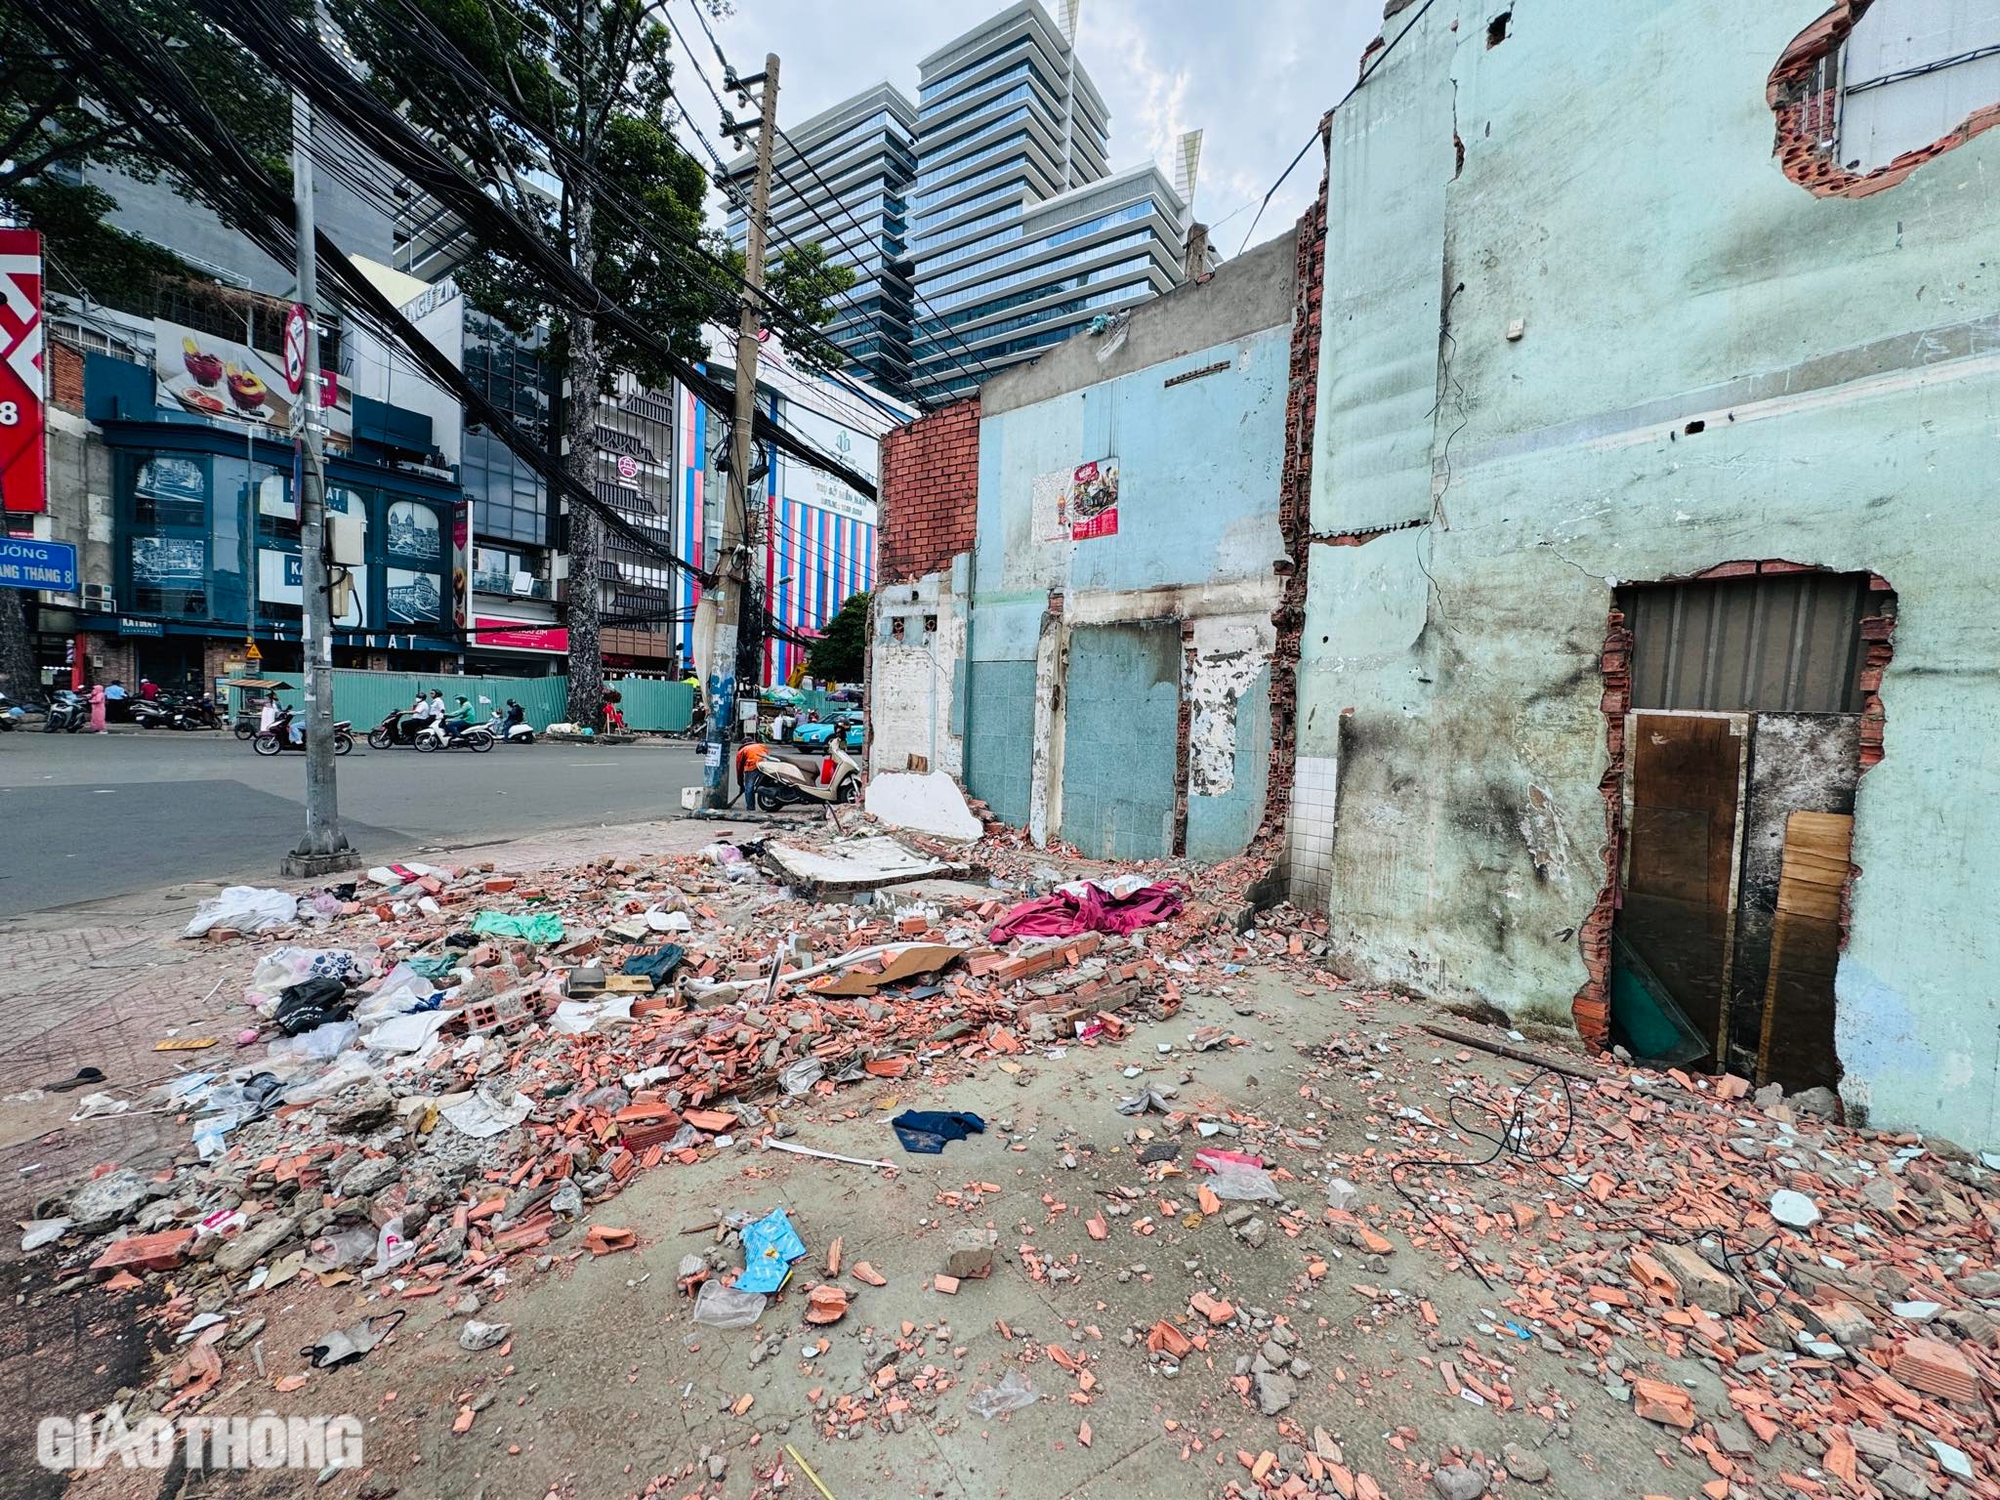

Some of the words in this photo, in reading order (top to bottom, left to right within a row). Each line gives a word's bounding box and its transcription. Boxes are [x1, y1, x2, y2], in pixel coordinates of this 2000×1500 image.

[23, 565, 61, 583] THÁNG
[64, 570, 72, 584] 8
[632, 945, 661, 956] DRY
